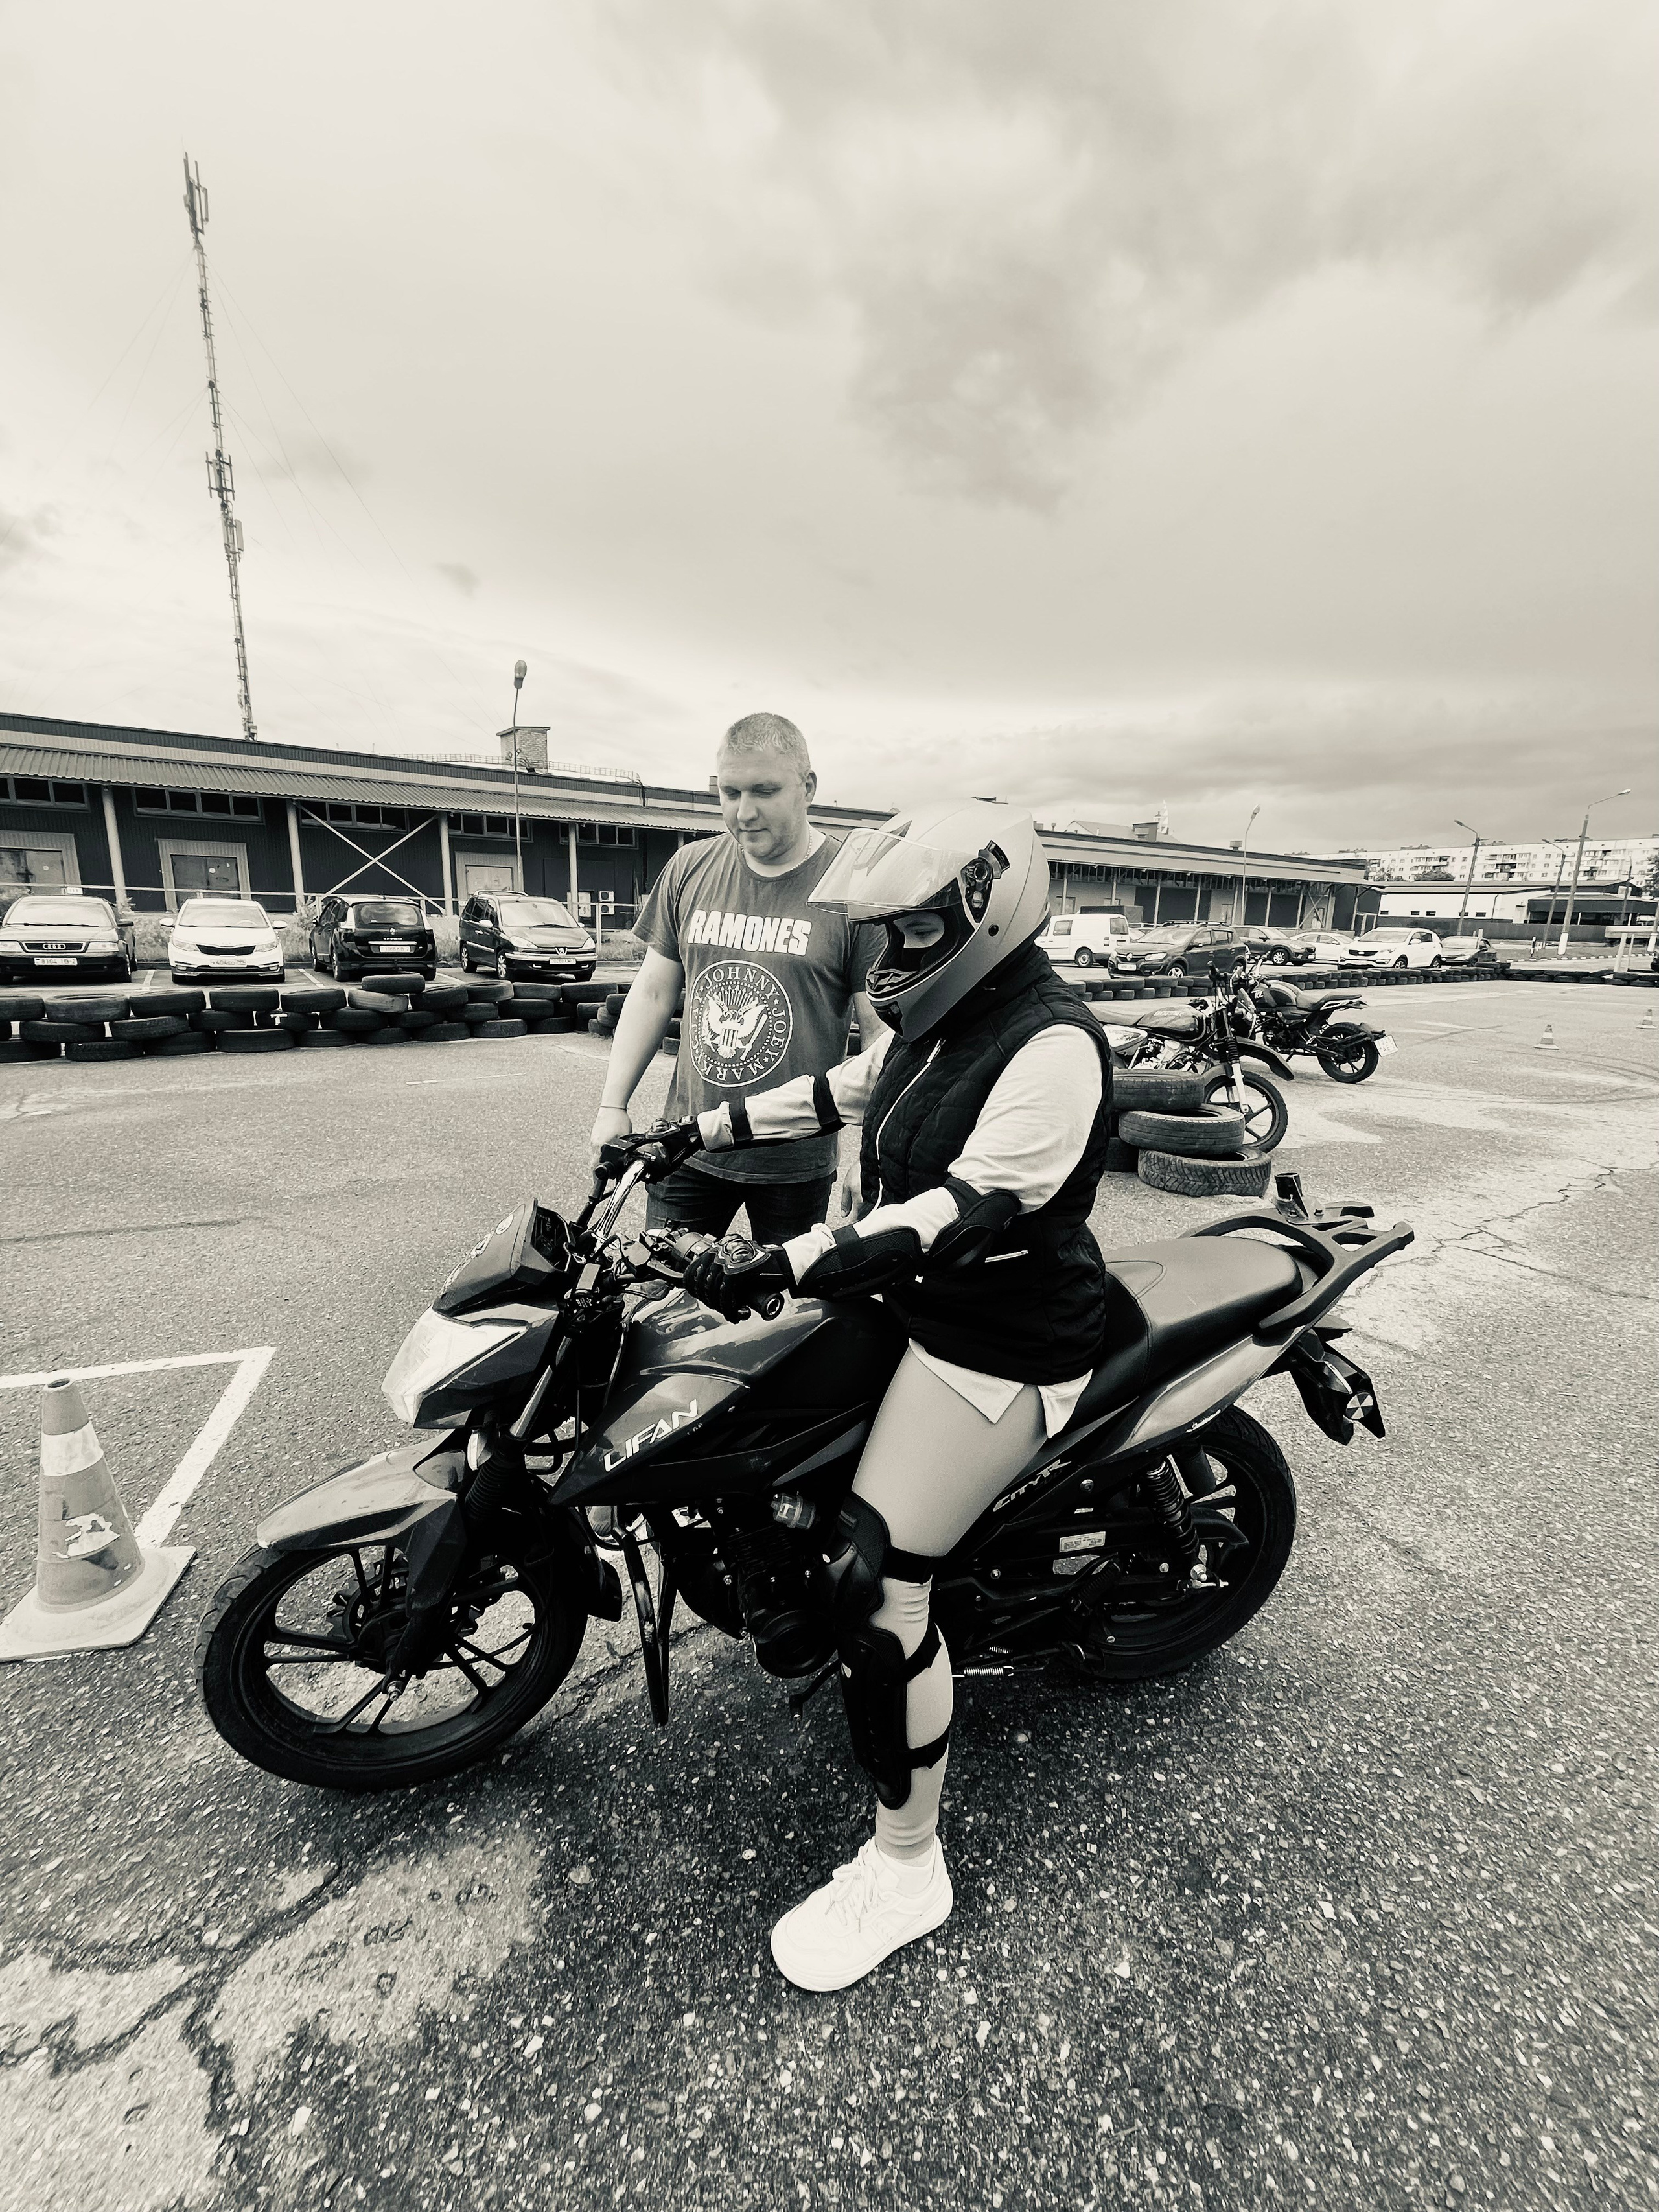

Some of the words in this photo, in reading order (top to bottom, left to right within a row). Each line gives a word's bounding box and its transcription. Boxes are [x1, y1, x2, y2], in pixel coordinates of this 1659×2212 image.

[687, 909, 812, 957] RAMONES
[704, 966, 780, 999] JOHNNY
[765, 1007, 787, 1062] JOEY
[695, 1052, 765, 1082] MARKY
[603, 1399, 698, 1472] LIFAN
